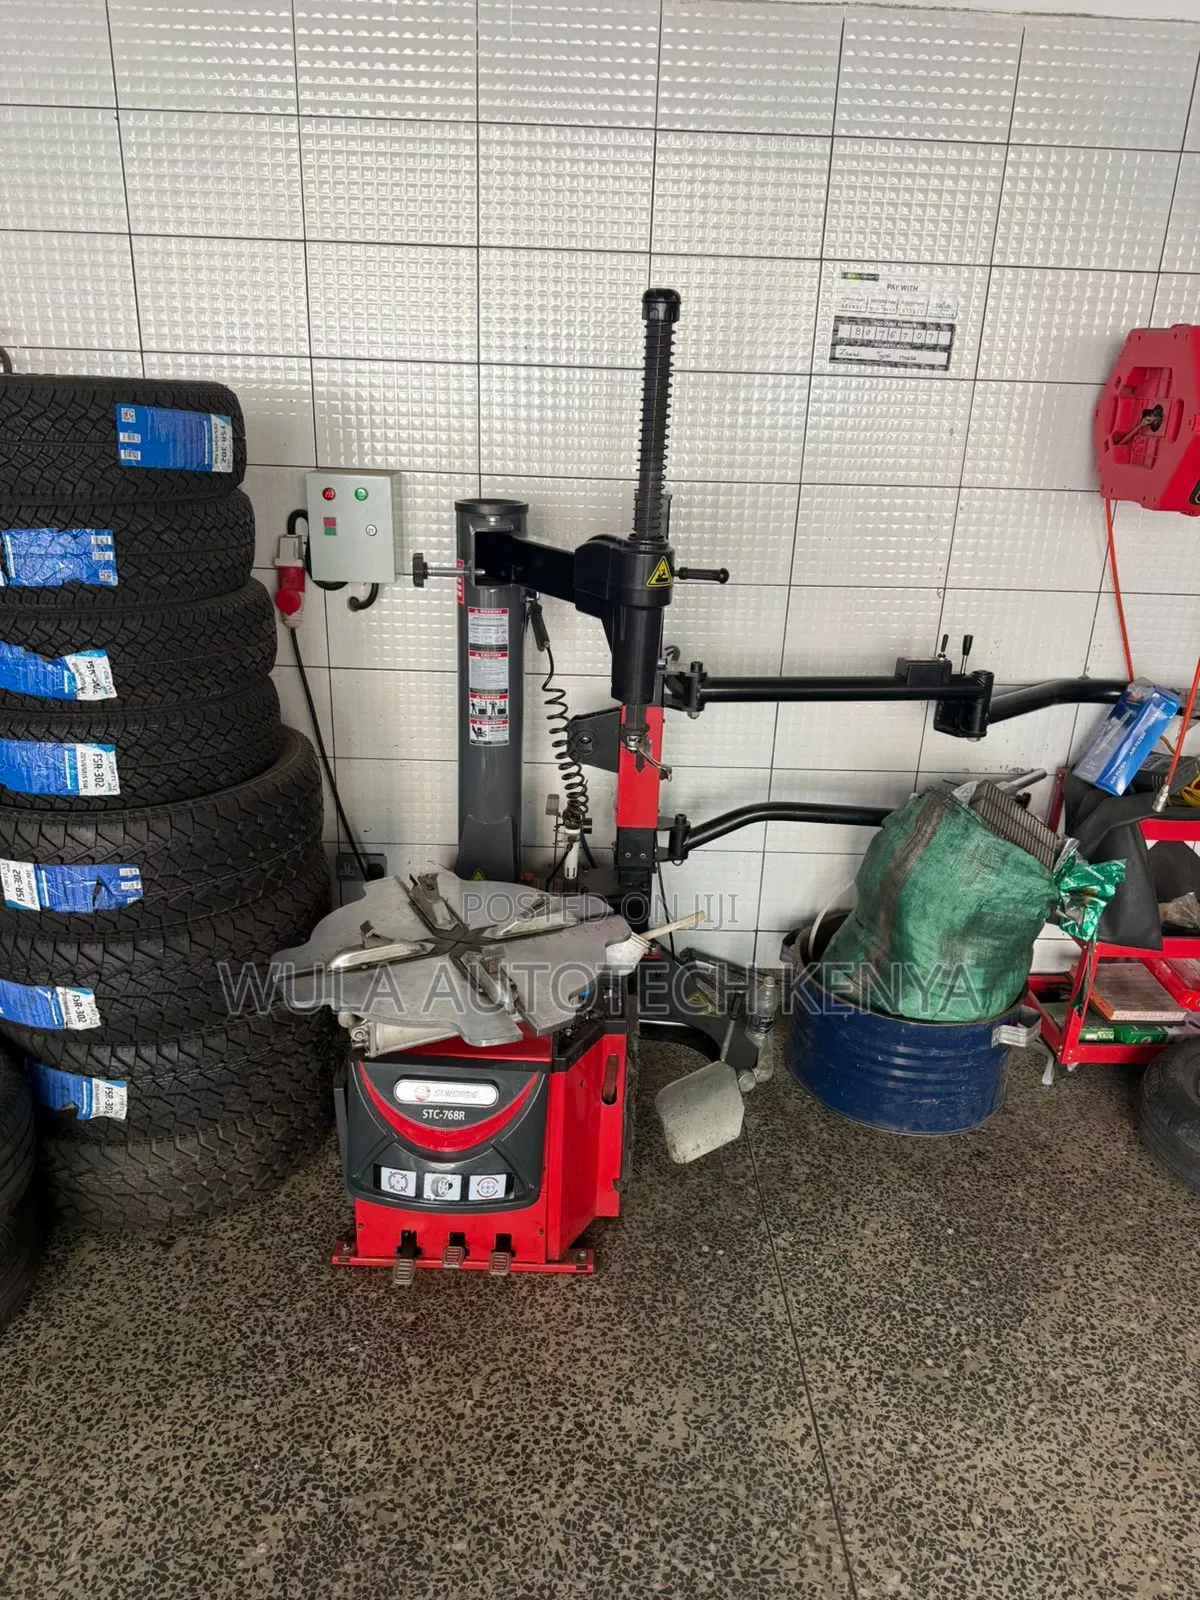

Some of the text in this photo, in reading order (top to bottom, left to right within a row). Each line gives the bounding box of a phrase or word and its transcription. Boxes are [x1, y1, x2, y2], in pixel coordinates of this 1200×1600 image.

[886, 283, 918, 293] PAY WITH
[92, 753, 105, 788] FSR-302
[12, 869, 25, 902] FSR-302
[71, 994, 87, 1023] FSR-302
[422, 1109, 465, 1121] STC-768R
